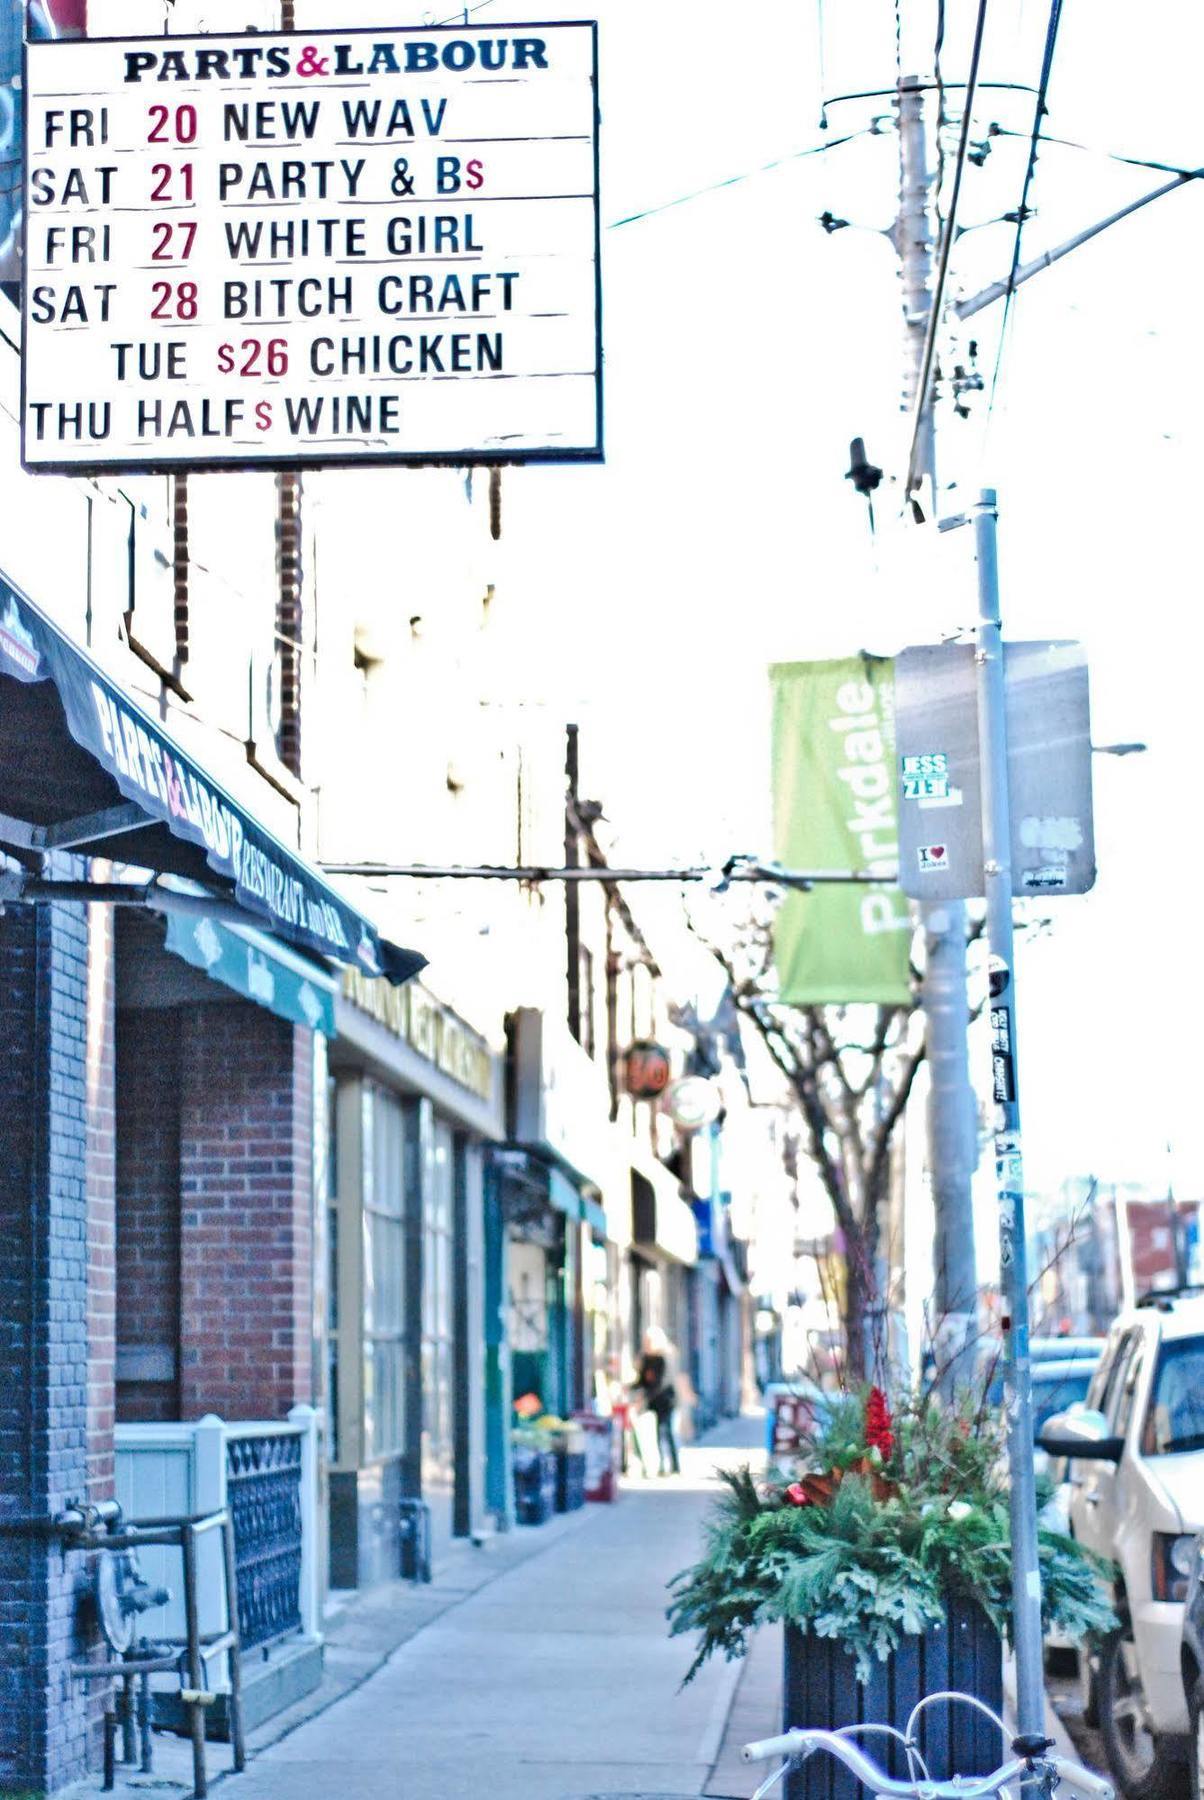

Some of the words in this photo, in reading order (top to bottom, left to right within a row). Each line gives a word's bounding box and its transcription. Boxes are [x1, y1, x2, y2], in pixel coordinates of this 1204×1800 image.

[124, 38, 549, 82] PARTS&LABOUR
[45, 108, 108, 148] FRI
[147, 104, 197, 144] 20
[224, 101, 320, 141] NEW
[342, 98, 447, 138] WAV
[31, 166, 118, 206] SAT
[150, 163, 193, 201] 21
[219, 159, 366, 201] PARTY
[390, 157, 415, 197] &
[46, 224, 110, 264] FRI
[151, 222, 198, 261] 27
[225, 218, 366, 259] WHITE
[386, 213, 484, 255] GIRL
[31, 284, 117, 324] SAT
[151, 281, 198, 320] 28
[224, 276, 352, 319] BITCH
[378, 272, 520, 315] CRAFT
[110, 342, 187, 381] TUE
[217, 338, 289, 377] $26
[310, 332, 502, 374] CHICKEN
[30, 402, 111, 441] THU
[284, 395, 400, 435] WINE
